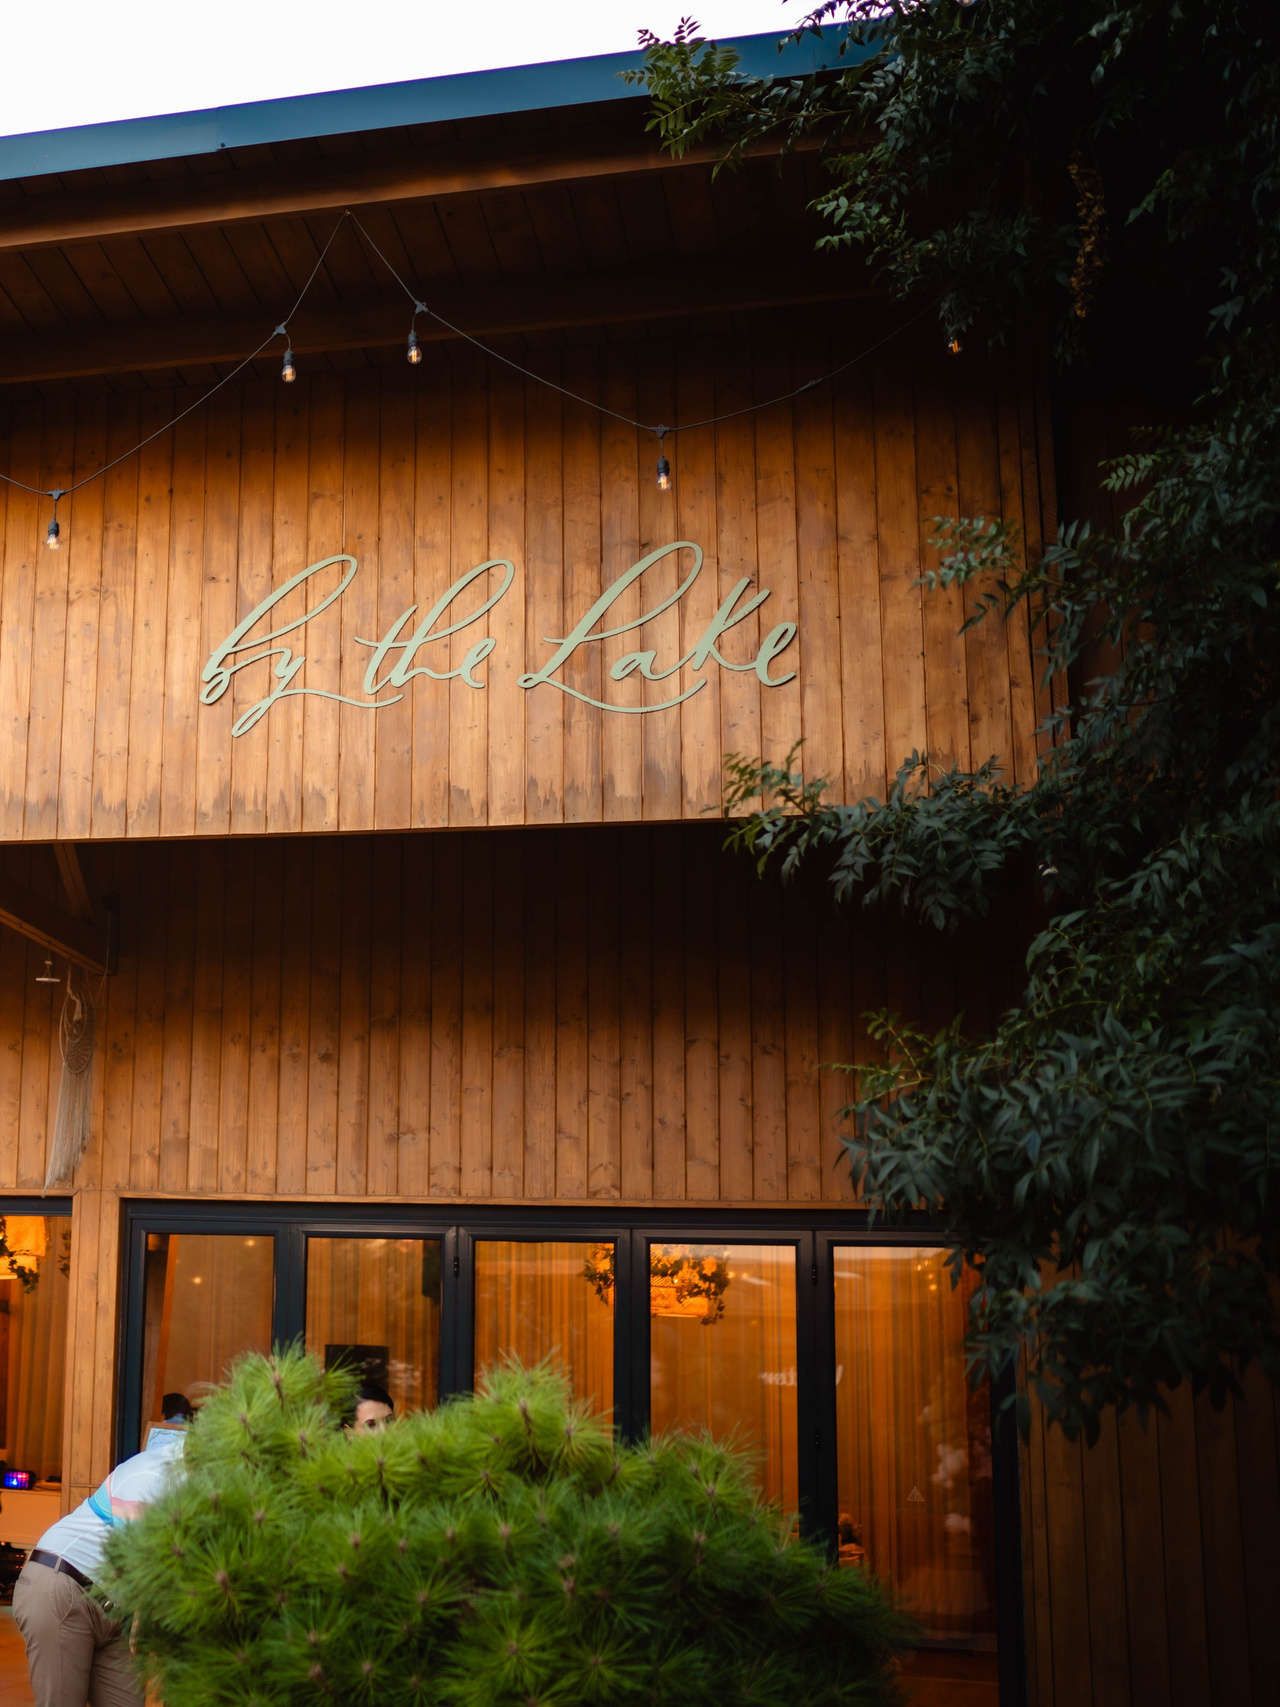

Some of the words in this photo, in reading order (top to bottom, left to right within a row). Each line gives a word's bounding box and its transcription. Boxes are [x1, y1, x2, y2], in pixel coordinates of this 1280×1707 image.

[200, 554, 403, 738] by
[354, 559, 514, 695] the
[517, 541, 796, 713] Lake
